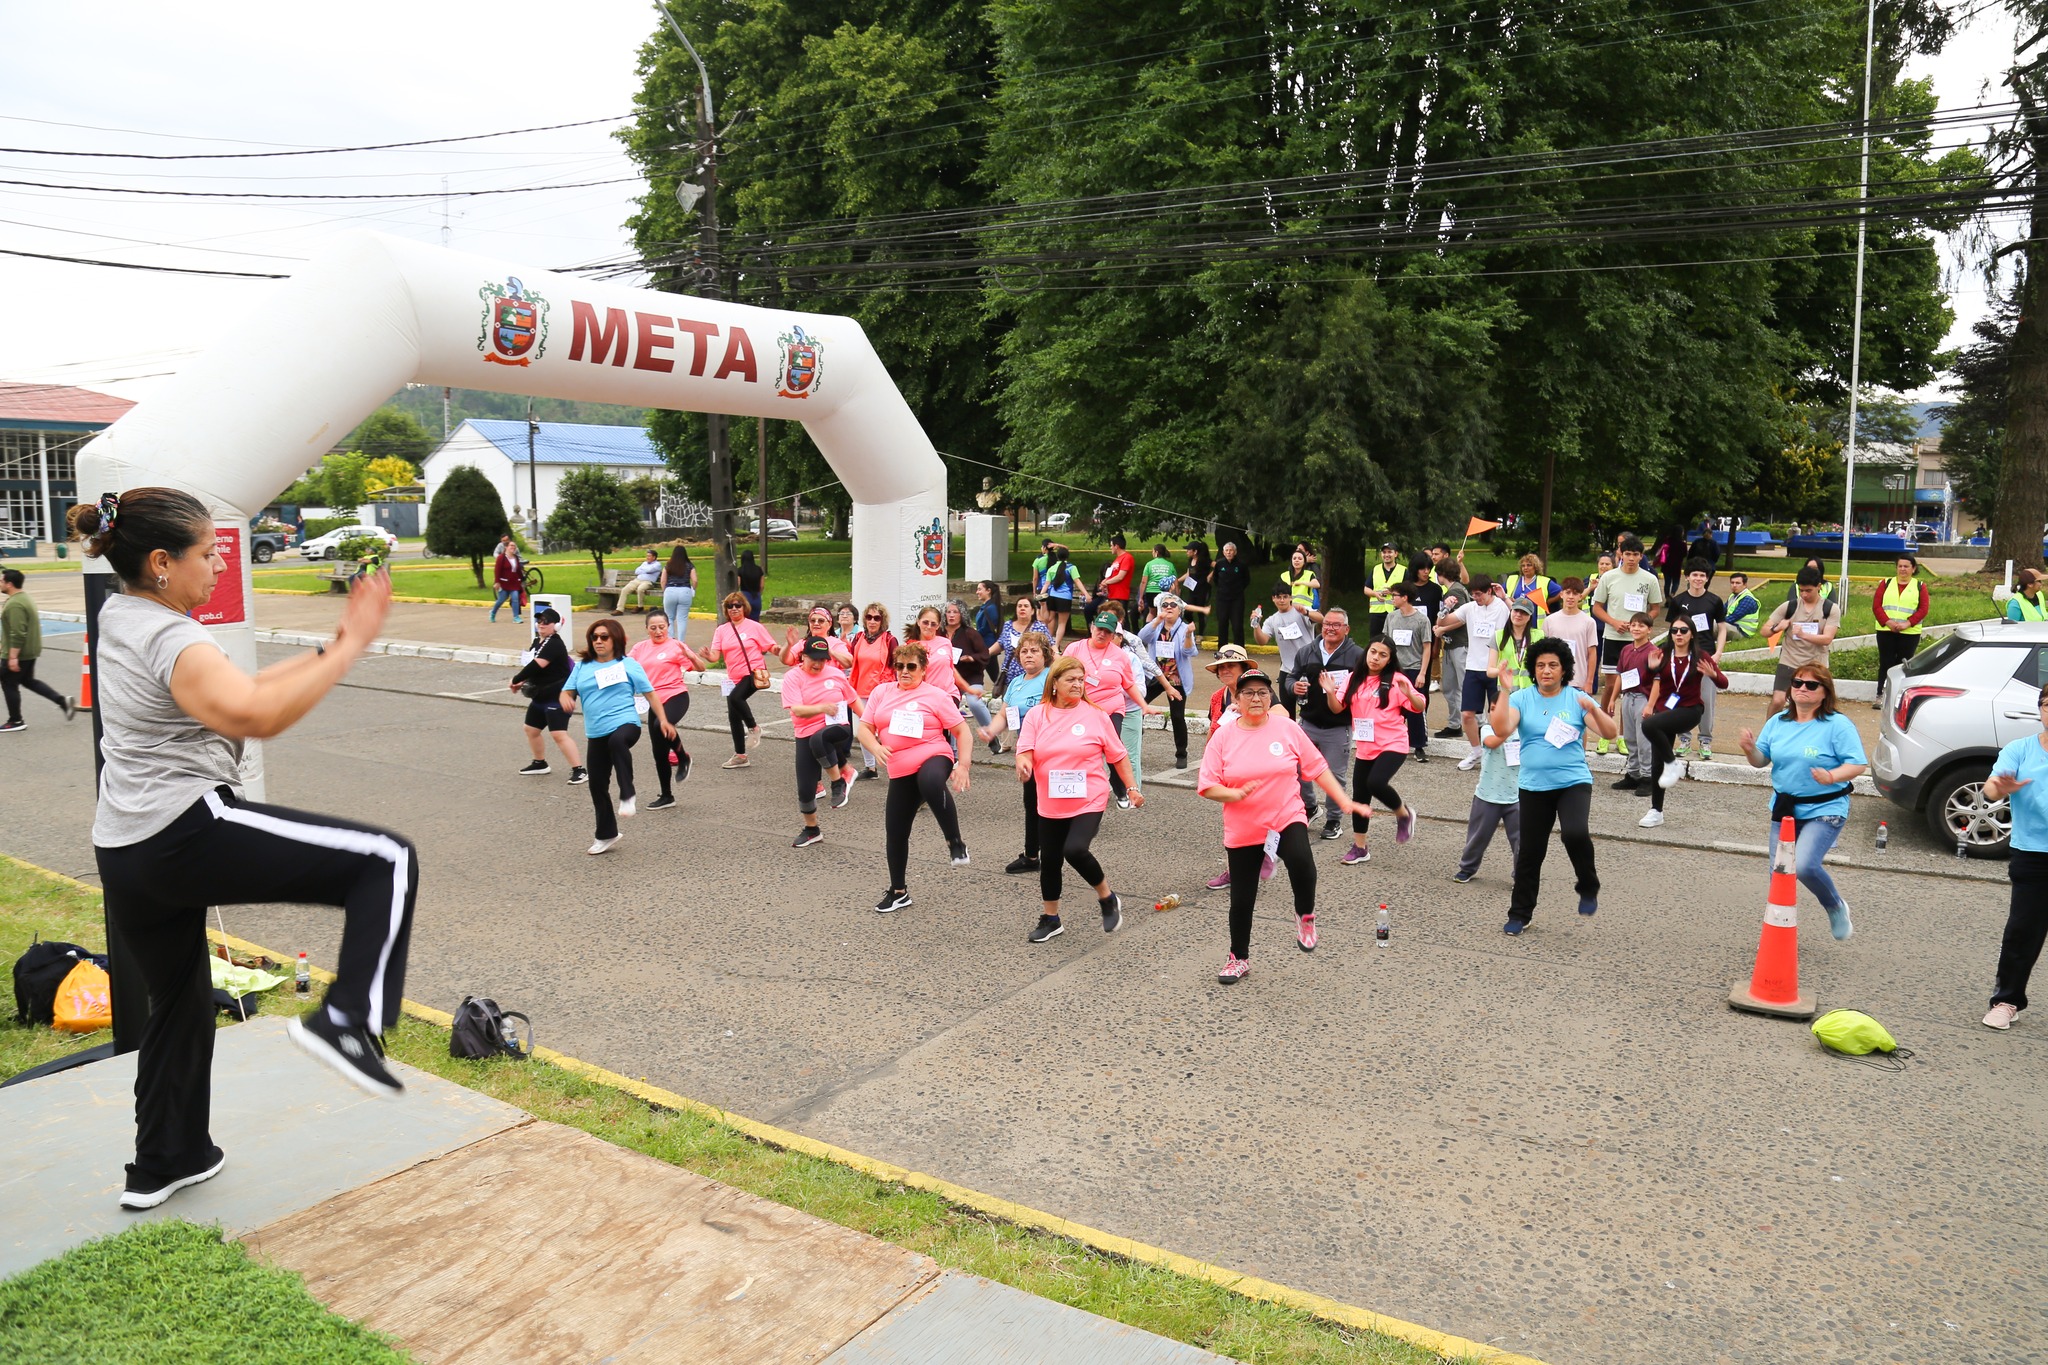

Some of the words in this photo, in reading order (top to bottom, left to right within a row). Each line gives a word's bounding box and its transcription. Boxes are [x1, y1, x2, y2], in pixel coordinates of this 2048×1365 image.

[568, 300, 758, 383] META
[198, 611, 224, 622] gob.cl
[1057, 784, 1077, 794] 061
